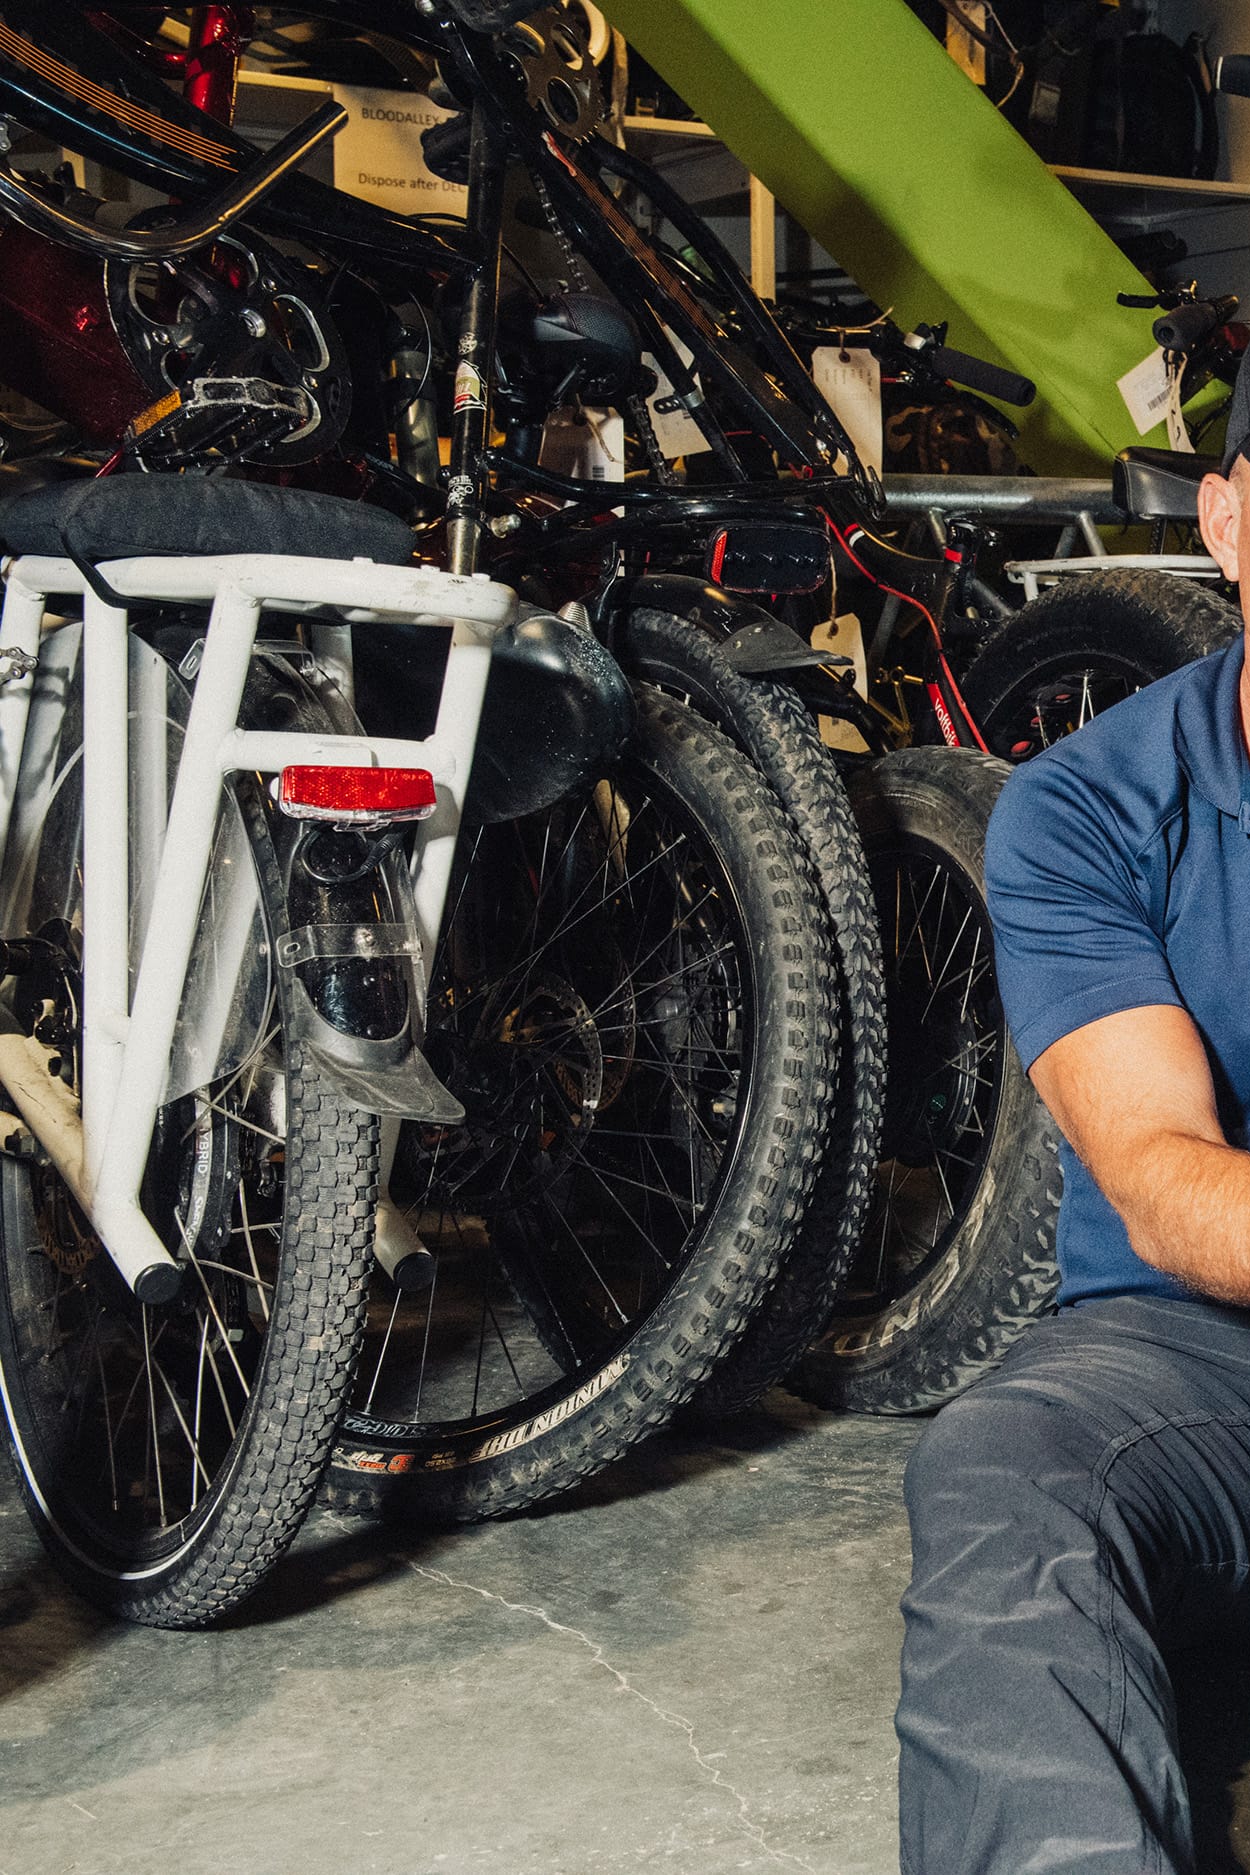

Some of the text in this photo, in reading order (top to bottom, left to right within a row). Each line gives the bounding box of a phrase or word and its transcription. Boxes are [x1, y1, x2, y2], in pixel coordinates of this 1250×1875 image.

[361, 107, 440, 126] BLOODALLEY
[358, 172, 406, 189] Dispose
[409, 178, 438, 191] after
[934, 697, 957, 747] voltbik
